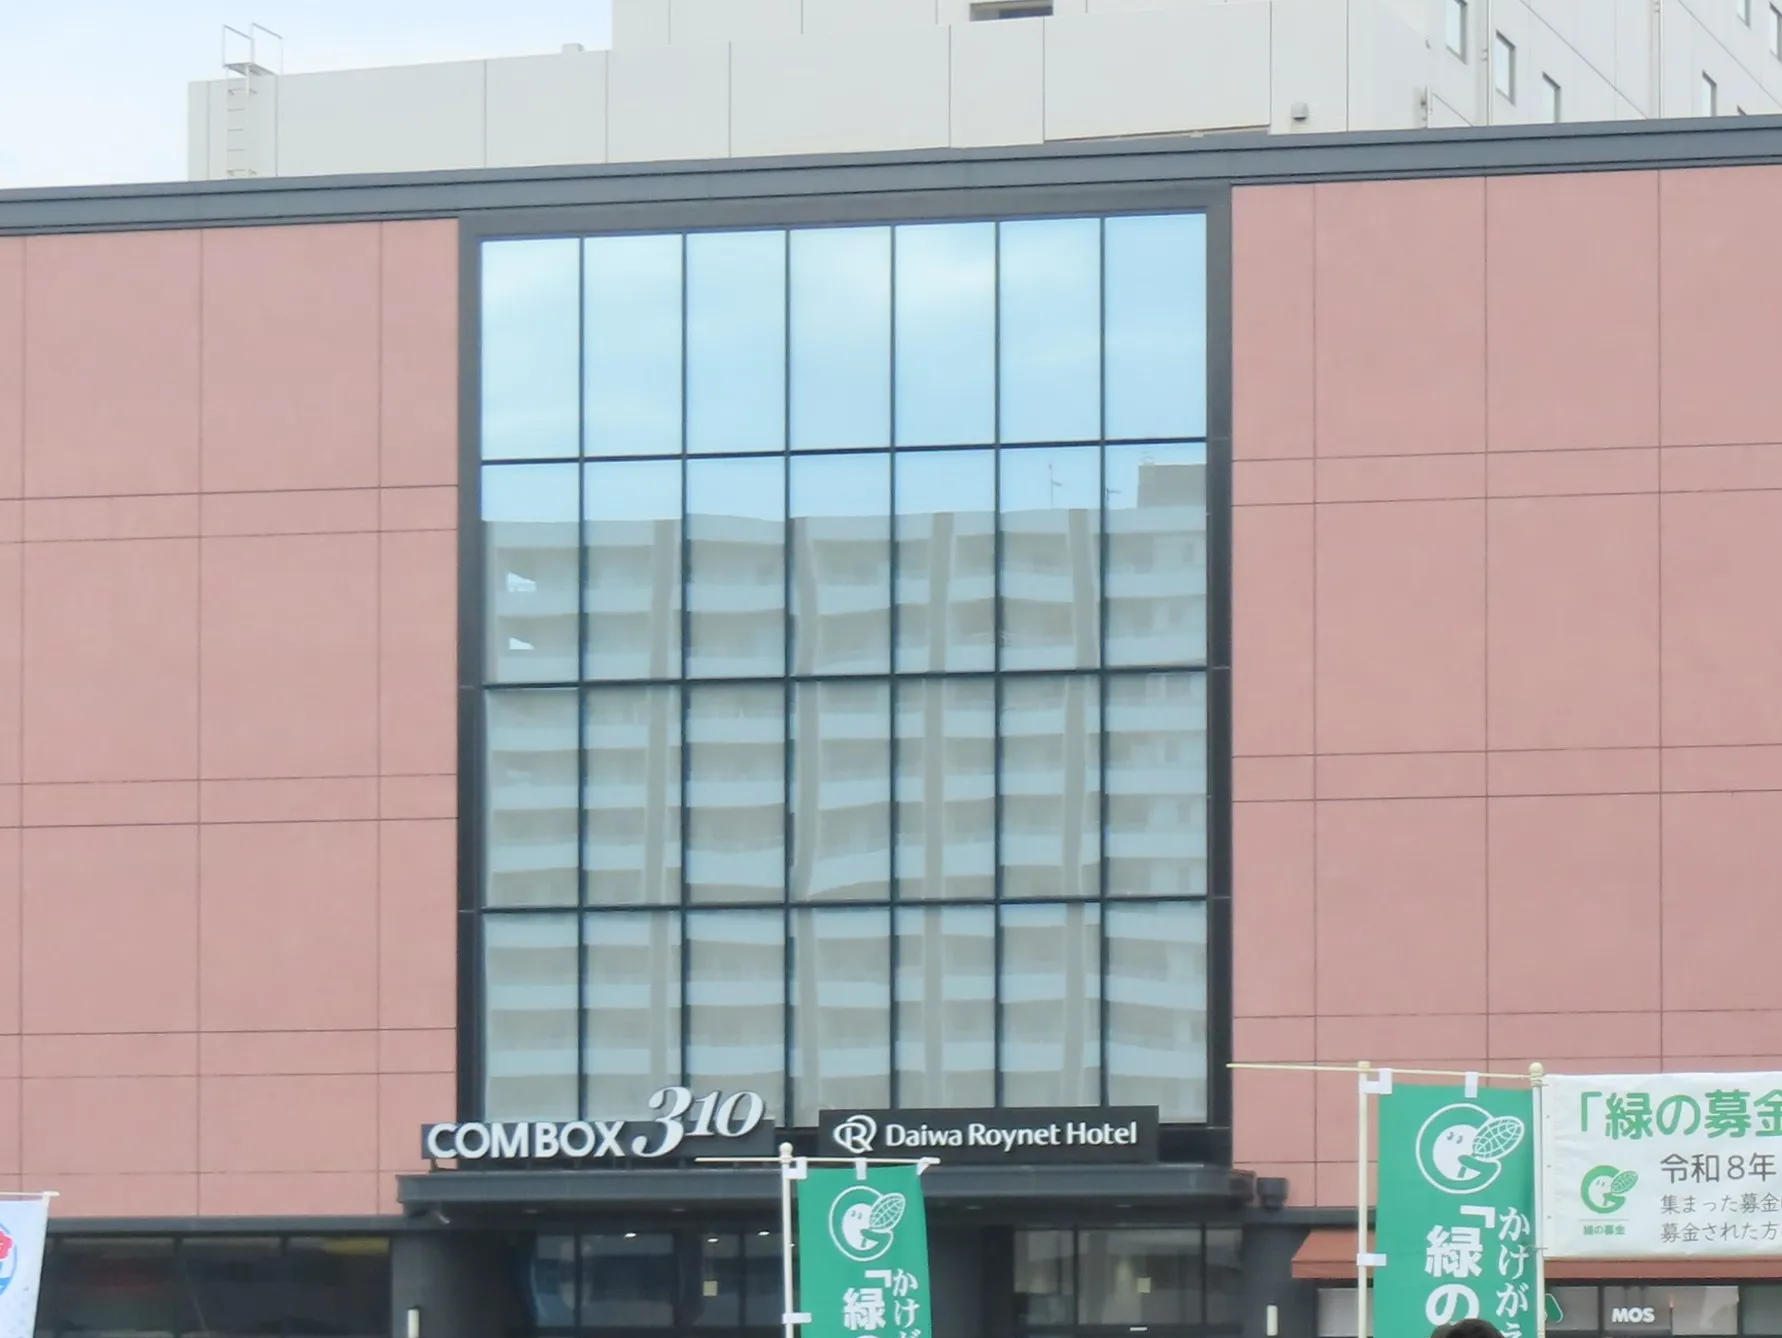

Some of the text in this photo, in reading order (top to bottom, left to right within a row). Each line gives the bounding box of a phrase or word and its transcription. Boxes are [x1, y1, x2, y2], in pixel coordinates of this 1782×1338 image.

[426, 1085, 765, 1161] COMBOX 310
[885, 1122, 962, 1149] Daiwa
[967, 1122, 1059, 1153] Roynet
[1066, 1120, 1138, 1146] Hotel
[1611, 1306, 1656, 1324] MOS
